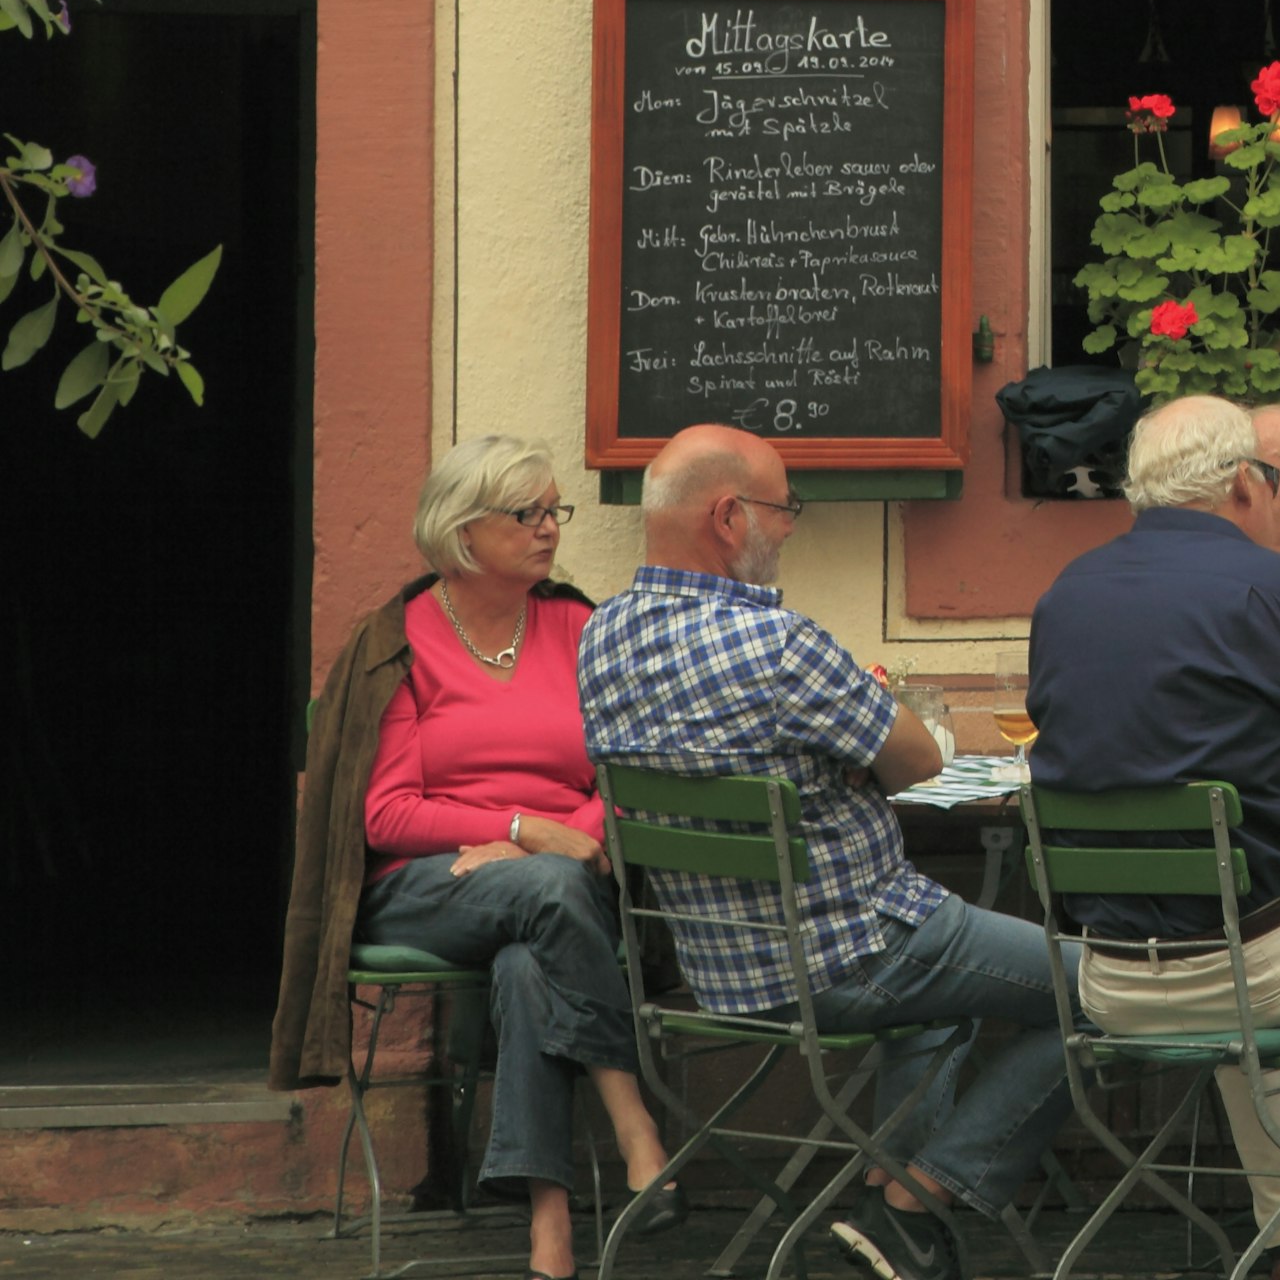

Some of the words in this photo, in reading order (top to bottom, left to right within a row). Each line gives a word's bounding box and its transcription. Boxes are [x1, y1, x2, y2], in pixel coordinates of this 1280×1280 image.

[686, 9, 891, 73] Mittagskarte
[675, 65, 706, 76] von
[798, 56, 894, 70] 19.09.2014
[633, 90, 682, 112] Mon:
[696, 81, 888, 127] Jägerschnitzel
[705, 119, 751, 137] mit
[762, 111, 852, 141] Spätzle
[630, 166, 692, 191] Dien:
[703, 151, 833, 183] Rinderleber
[841, 161, 890, 176] sauer
[899, 152, 936, 174] oder
[786, 182, 816, 199] mit
[823, 177, 905, 206] Brägele
[637, 225, 687, 248] Mitt:
[747, 211, 900, 245] Hühnchenbrust
[702, 250, 785, 271] Chilireis
[799, 246, 919, 274] Paprikasauce
[628, 290, 680, 311] Don.
[859, 272, 939, 297] Rotkraut
[713, 304, 839, 339] Kartoffelbrei
[627, 347, 676, 372] Frei:
[690, 337, 823, 367] Lachsschnitte
[829, 337, 859, 368] auf
[864, 337, 930, 362] Rahm
[687, 366, 756, 398] Spinat
[765, 370, 797, 389] und
[808, 366, 861, 387] Rösti
